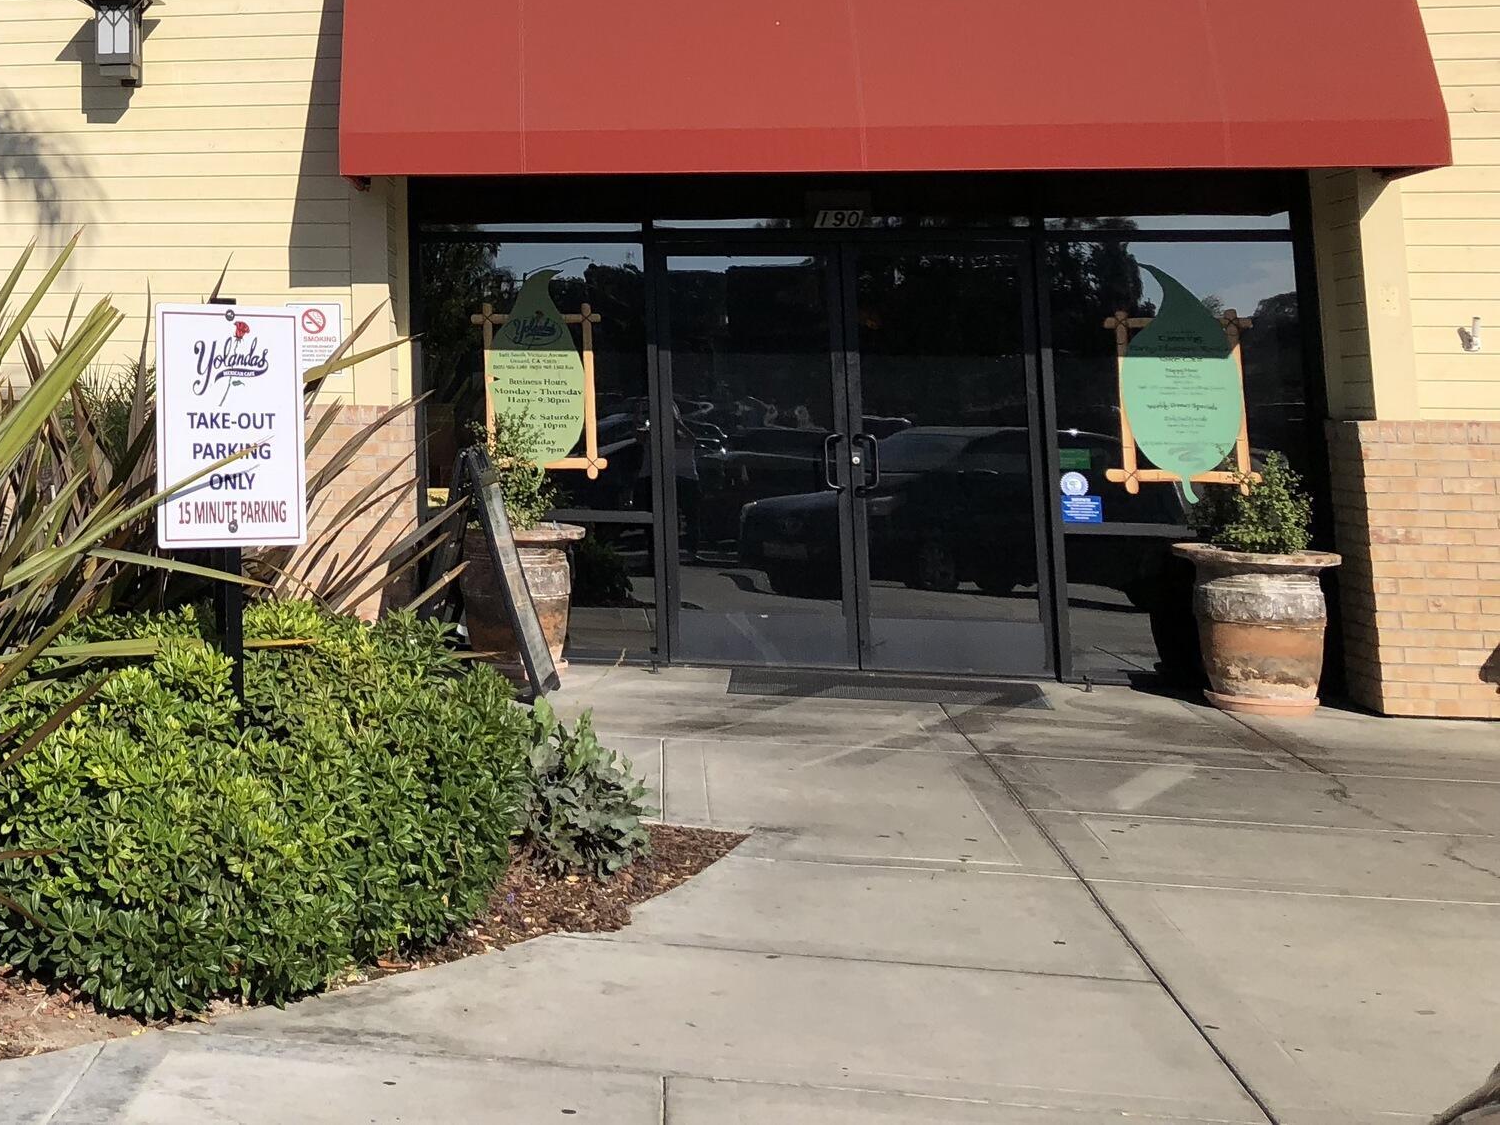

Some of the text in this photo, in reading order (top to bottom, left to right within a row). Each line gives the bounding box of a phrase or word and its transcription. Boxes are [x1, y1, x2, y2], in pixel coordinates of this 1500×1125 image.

[820, 211, 860, 227] 190
[192, 336, 269, 396] Yolandas
[509, 377, 568, 386] Business Hours
[494, 388, 531, 396] Monday
[186, 412, 276, 430] TAKE-OUT
[539, 413, 580, 422] Saturday
[543, 422, 567, 430] 10pm
[192, 442, 271, 460] PARKING
[545, 446, 565, 454] 9pm
[209, 472, 256, 491] ONLY
[178, 500, 287, 525] 15 MINUTE PARKING
